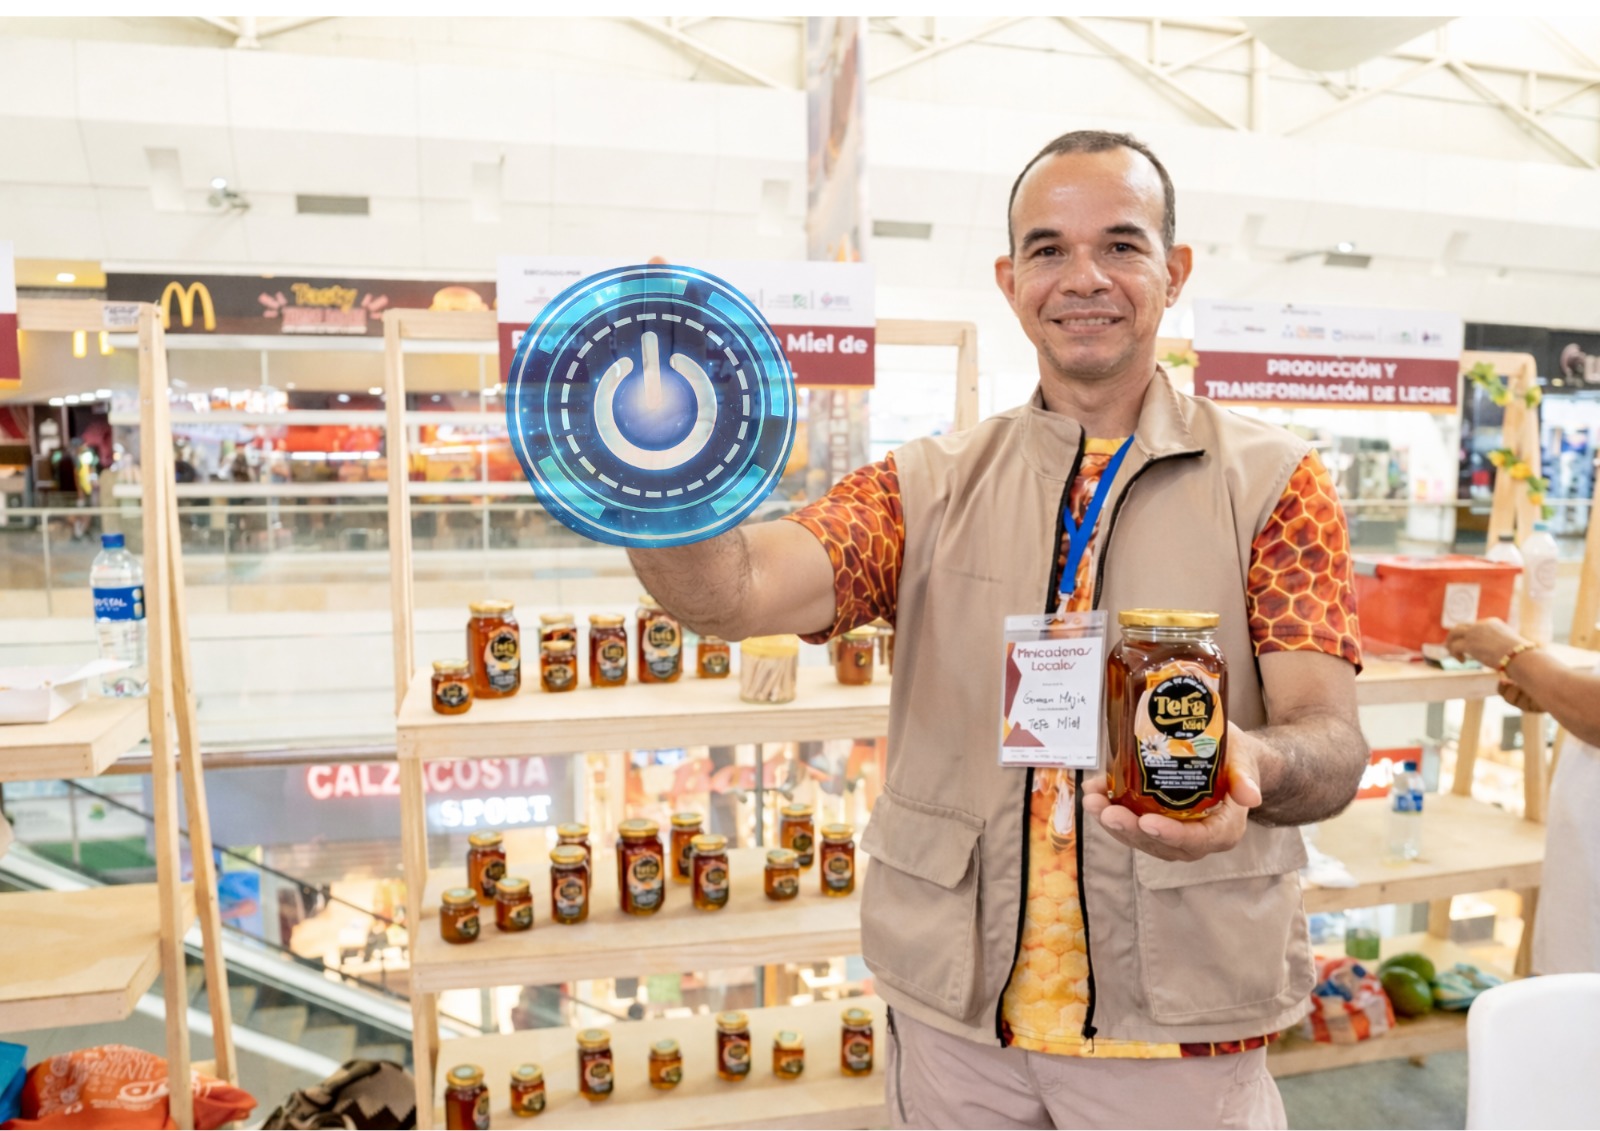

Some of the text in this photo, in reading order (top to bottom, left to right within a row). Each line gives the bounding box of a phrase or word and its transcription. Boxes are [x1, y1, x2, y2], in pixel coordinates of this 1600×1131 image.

[787, 331, 835, 353] Miel
[839, 334, 868, 354] de
[1267, 357, 1398, 379] PRODUCCIÓN Y
[1205, 380, 1452, 404] TRANSFORMACIÓN DE LECHE
[440, 795, 552, 827] SPORT
